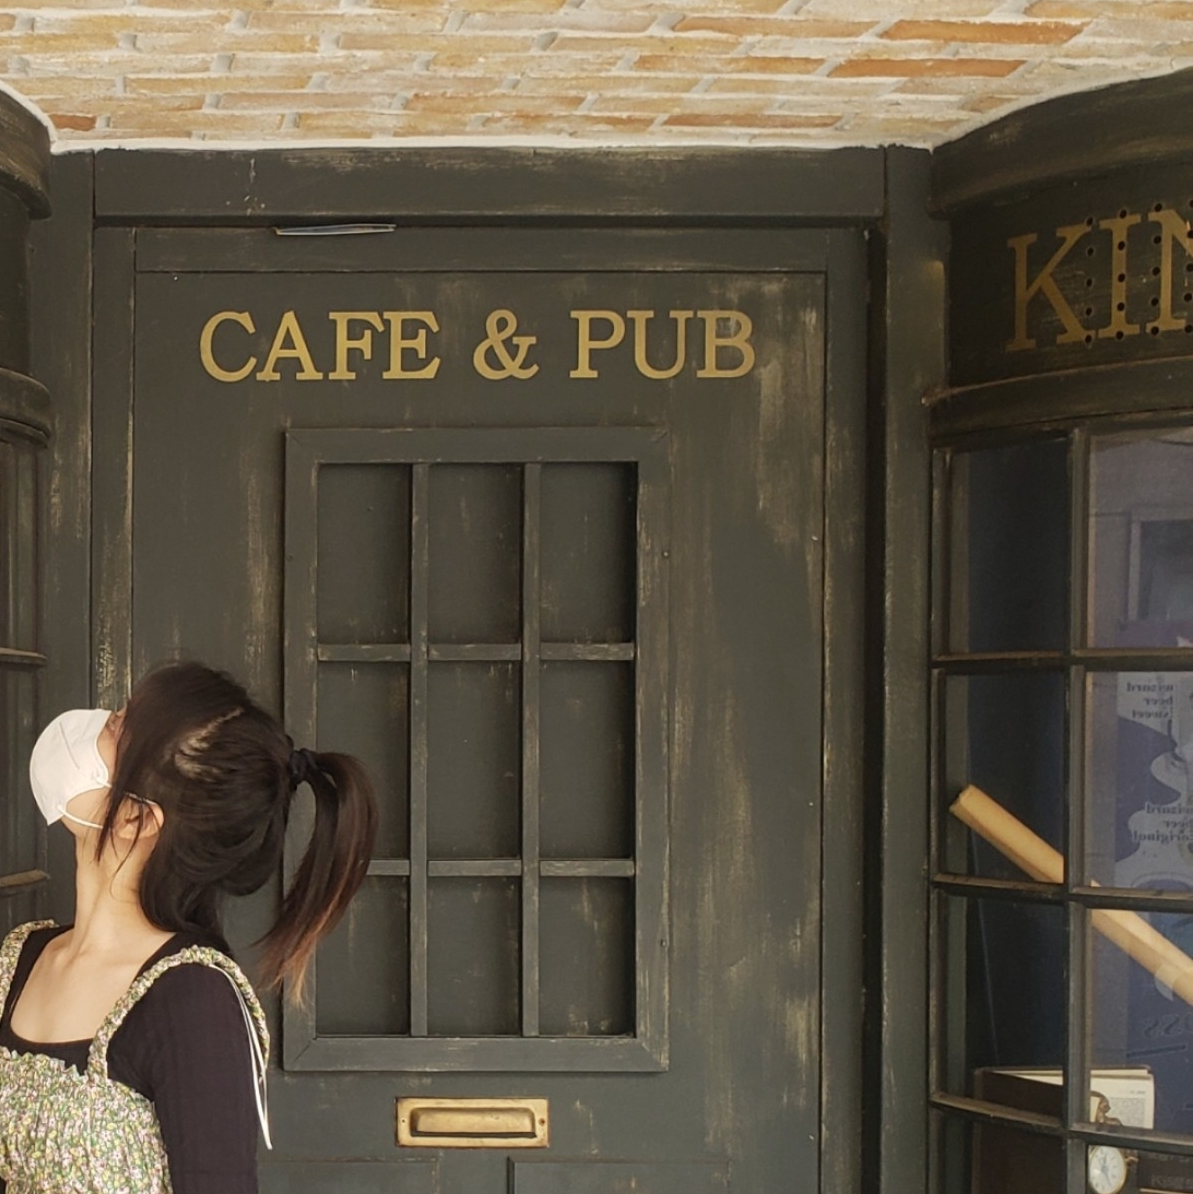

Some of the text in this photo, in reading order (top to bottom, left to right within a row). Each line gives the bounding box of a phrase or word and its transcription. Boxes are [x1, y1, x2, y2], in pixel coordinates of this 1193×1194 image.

[199, 309, 757, 382] CAFE & PUB
